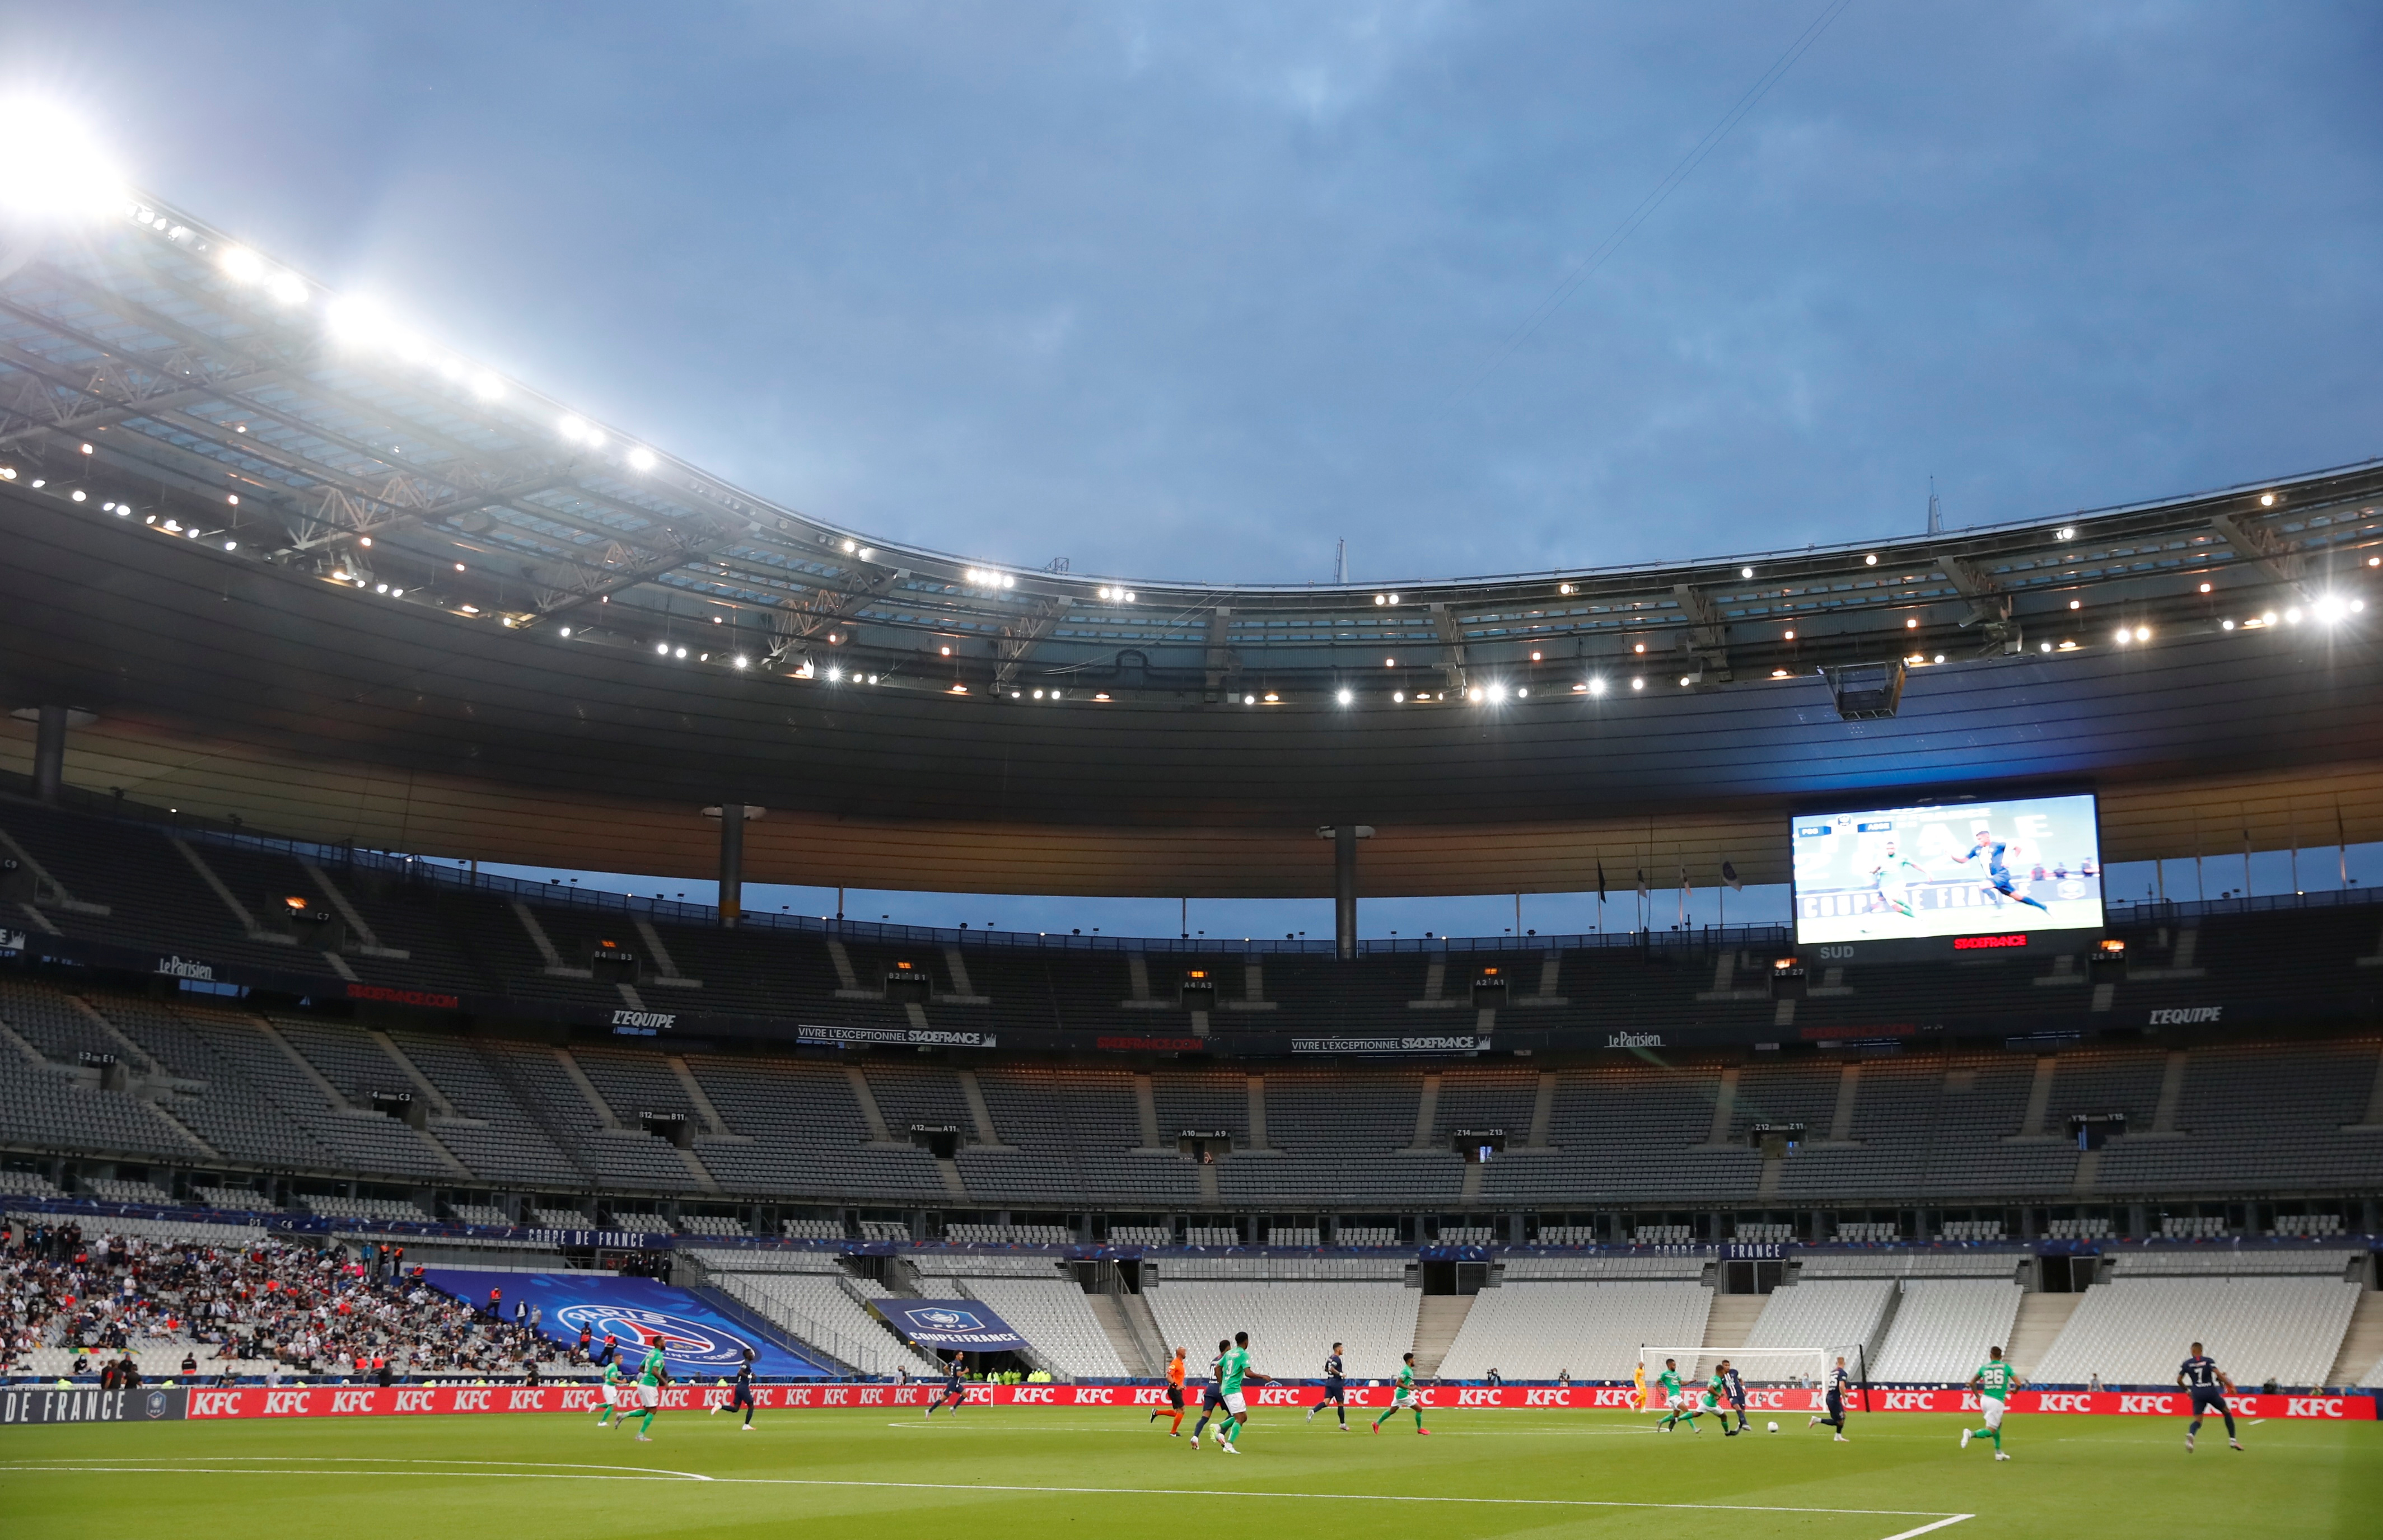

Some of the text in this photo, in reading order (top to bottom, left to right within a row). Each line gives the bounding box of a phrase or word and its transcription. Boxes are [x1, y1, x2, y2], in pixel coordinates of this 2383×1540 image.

[1954, 934, 2027, 949] STADEFRANCE
[1820, 945, 1854, 959] SUD
[798, 1027, 826, 1038] VIVRE
[829, 1029, 907, 1042] L'EXCEPTIONNEL
[1291, 1041, 1319, 1050] VIVRE
[1322, 1040, 1399, 1050] L'EXCEPTIONNEL
[529, 1228, 644, 1247] COUPE DE FRANCE
[1731, 1244, 1780, 1257] FRANCE
[567, 1307, 667, 1323] PARIS
[961, 1333, 1020, 1343] FRANCE
[1984, 1369, 2004, 1385] 26
[192, 1392, 241, 1415] KFC
[264, 1392, 310, 1413] KFC
[331, 1391, 375, 1412] KFC
[394, 1391, 434, 1411] KFC
[454, 1390, 491, 1410] KFC
[508, 1389, 545, 1410] KFC
[561, 1389, 595, 1408] KFC
[659, 1389, 689, 1407] KFC
[703, 1389, 732, 1407] KFC
[785, 1389, 812, 1405] KFC
[823, 1389, 848, 1405] KFC
[859, 1388, 884, 1404] KFC
[894, 1388, 917, 1403] KFC
[1012, 1388, 1055, 1403] KFC
[1073, 1388, 1114, 1404] KFC
[1133, 1389, 1169, 1404] KFC
[1257, 1389, 1300, 1404] KFC
[1457, 1389, 1502, 1405] KFC
[1524, 1389, 1571, 1405] KFC
[1594, 1390, 1637, 1406] KFC
[1744, 1391, 1784, 1408] KFC
[1884, 1393, 1934, 1410] KFC
[2039, 1394, 2091, 1412] KFC
[4, 1391, 125, 1422] DE FRANCE
[2119, 1396, 2173, 1413] KFC
[2286, 1398, 2343, 1417] KFC
